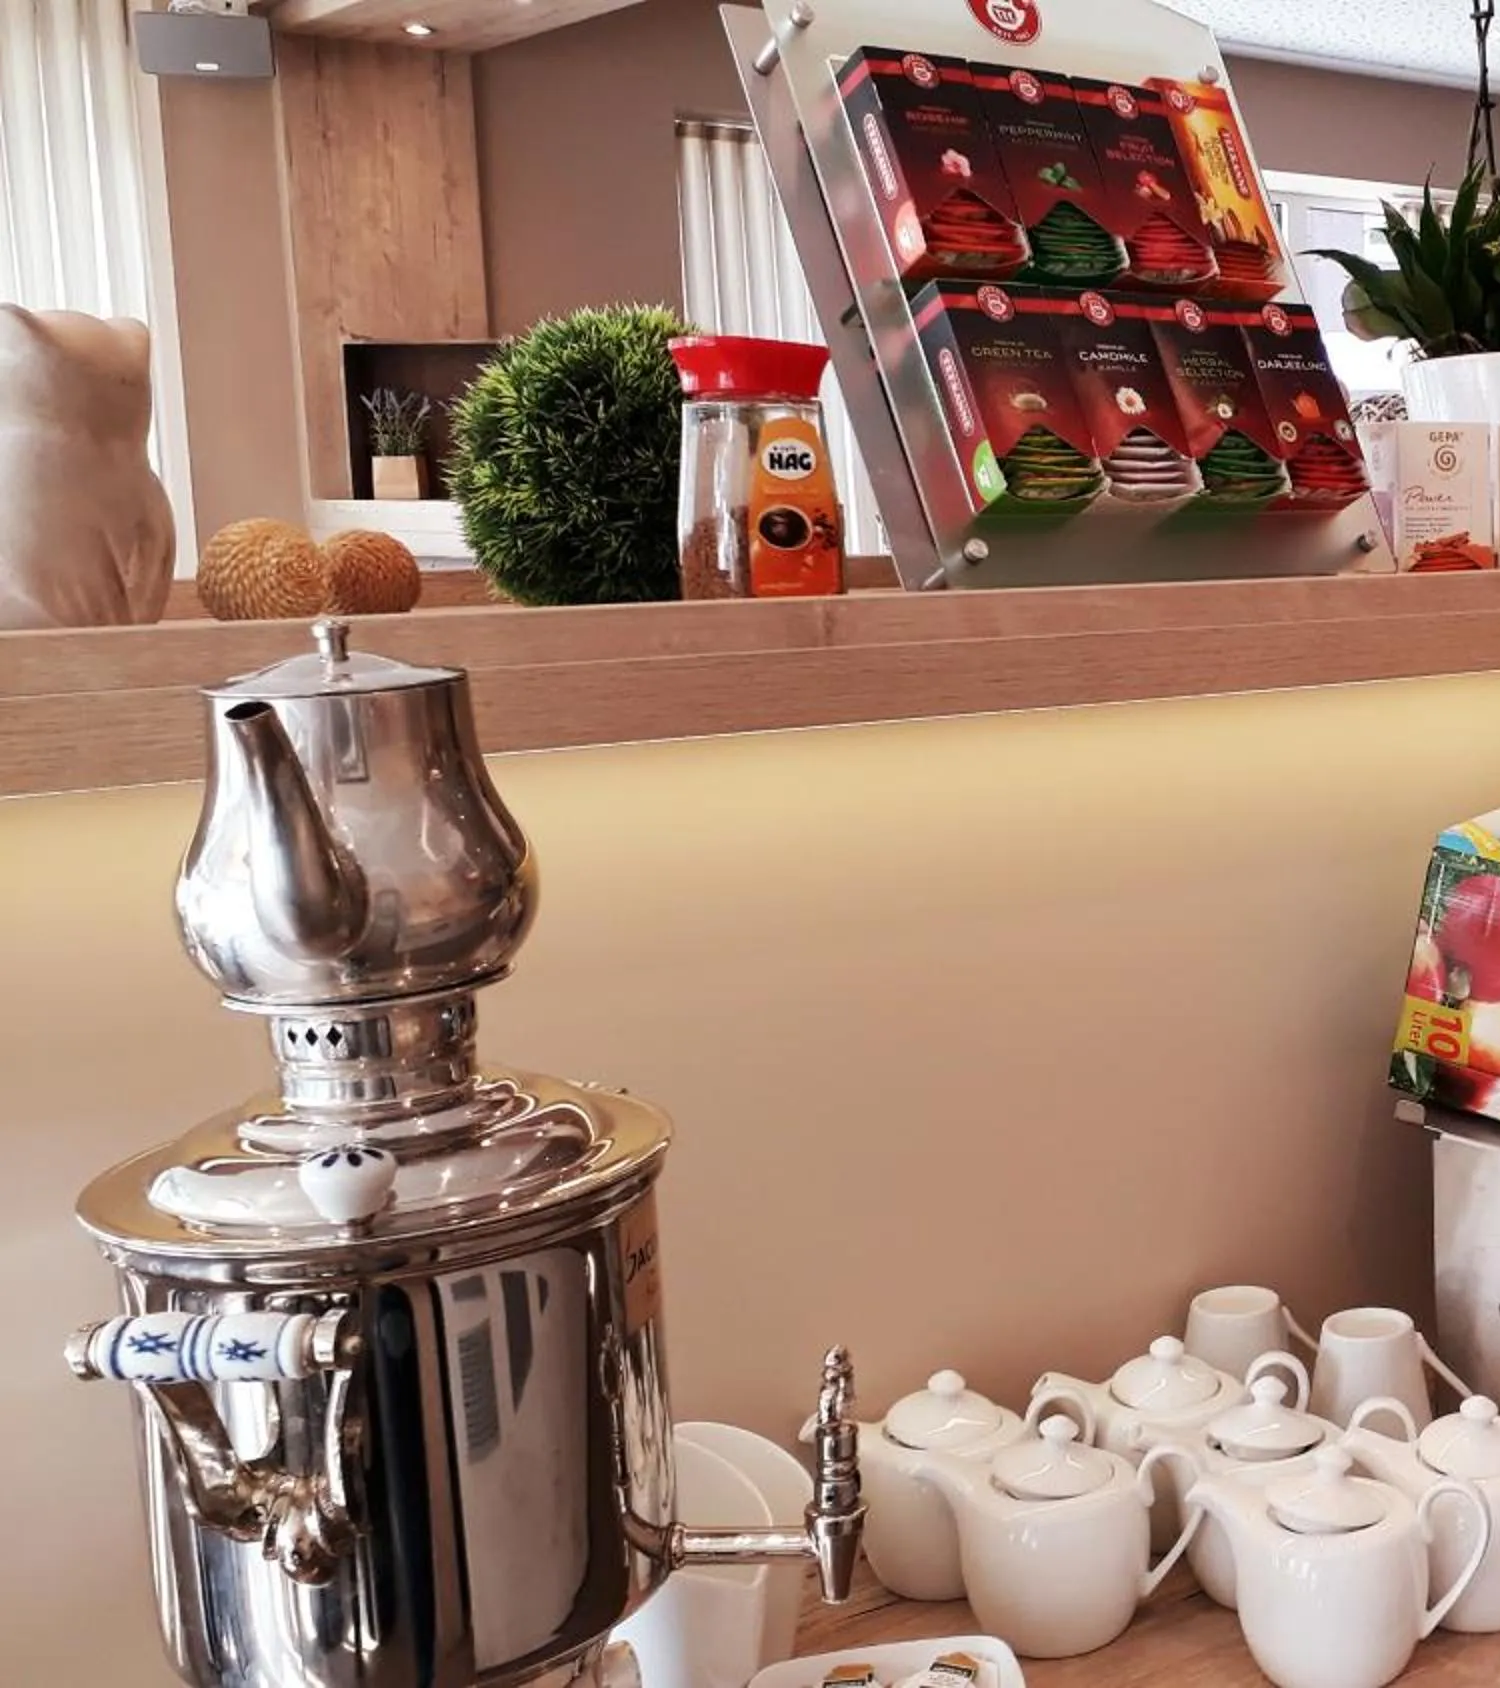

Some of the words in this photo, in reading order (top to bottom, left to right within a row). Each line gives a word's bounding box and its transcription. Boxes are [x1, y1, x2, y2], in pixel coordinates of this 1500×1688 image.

[971, 346, 1021, 359] GREEN
[1023, 348, 1053, 360] TEA
[1079, 351, 1149, 363] CAMOMILE
[1429, 431, 1461, 443] GEPA
[769, 452, 812, 471] HAG
[1407, 1010, 1428, 1048] Liter
[1428, 1015, 1464, 1063] 10
